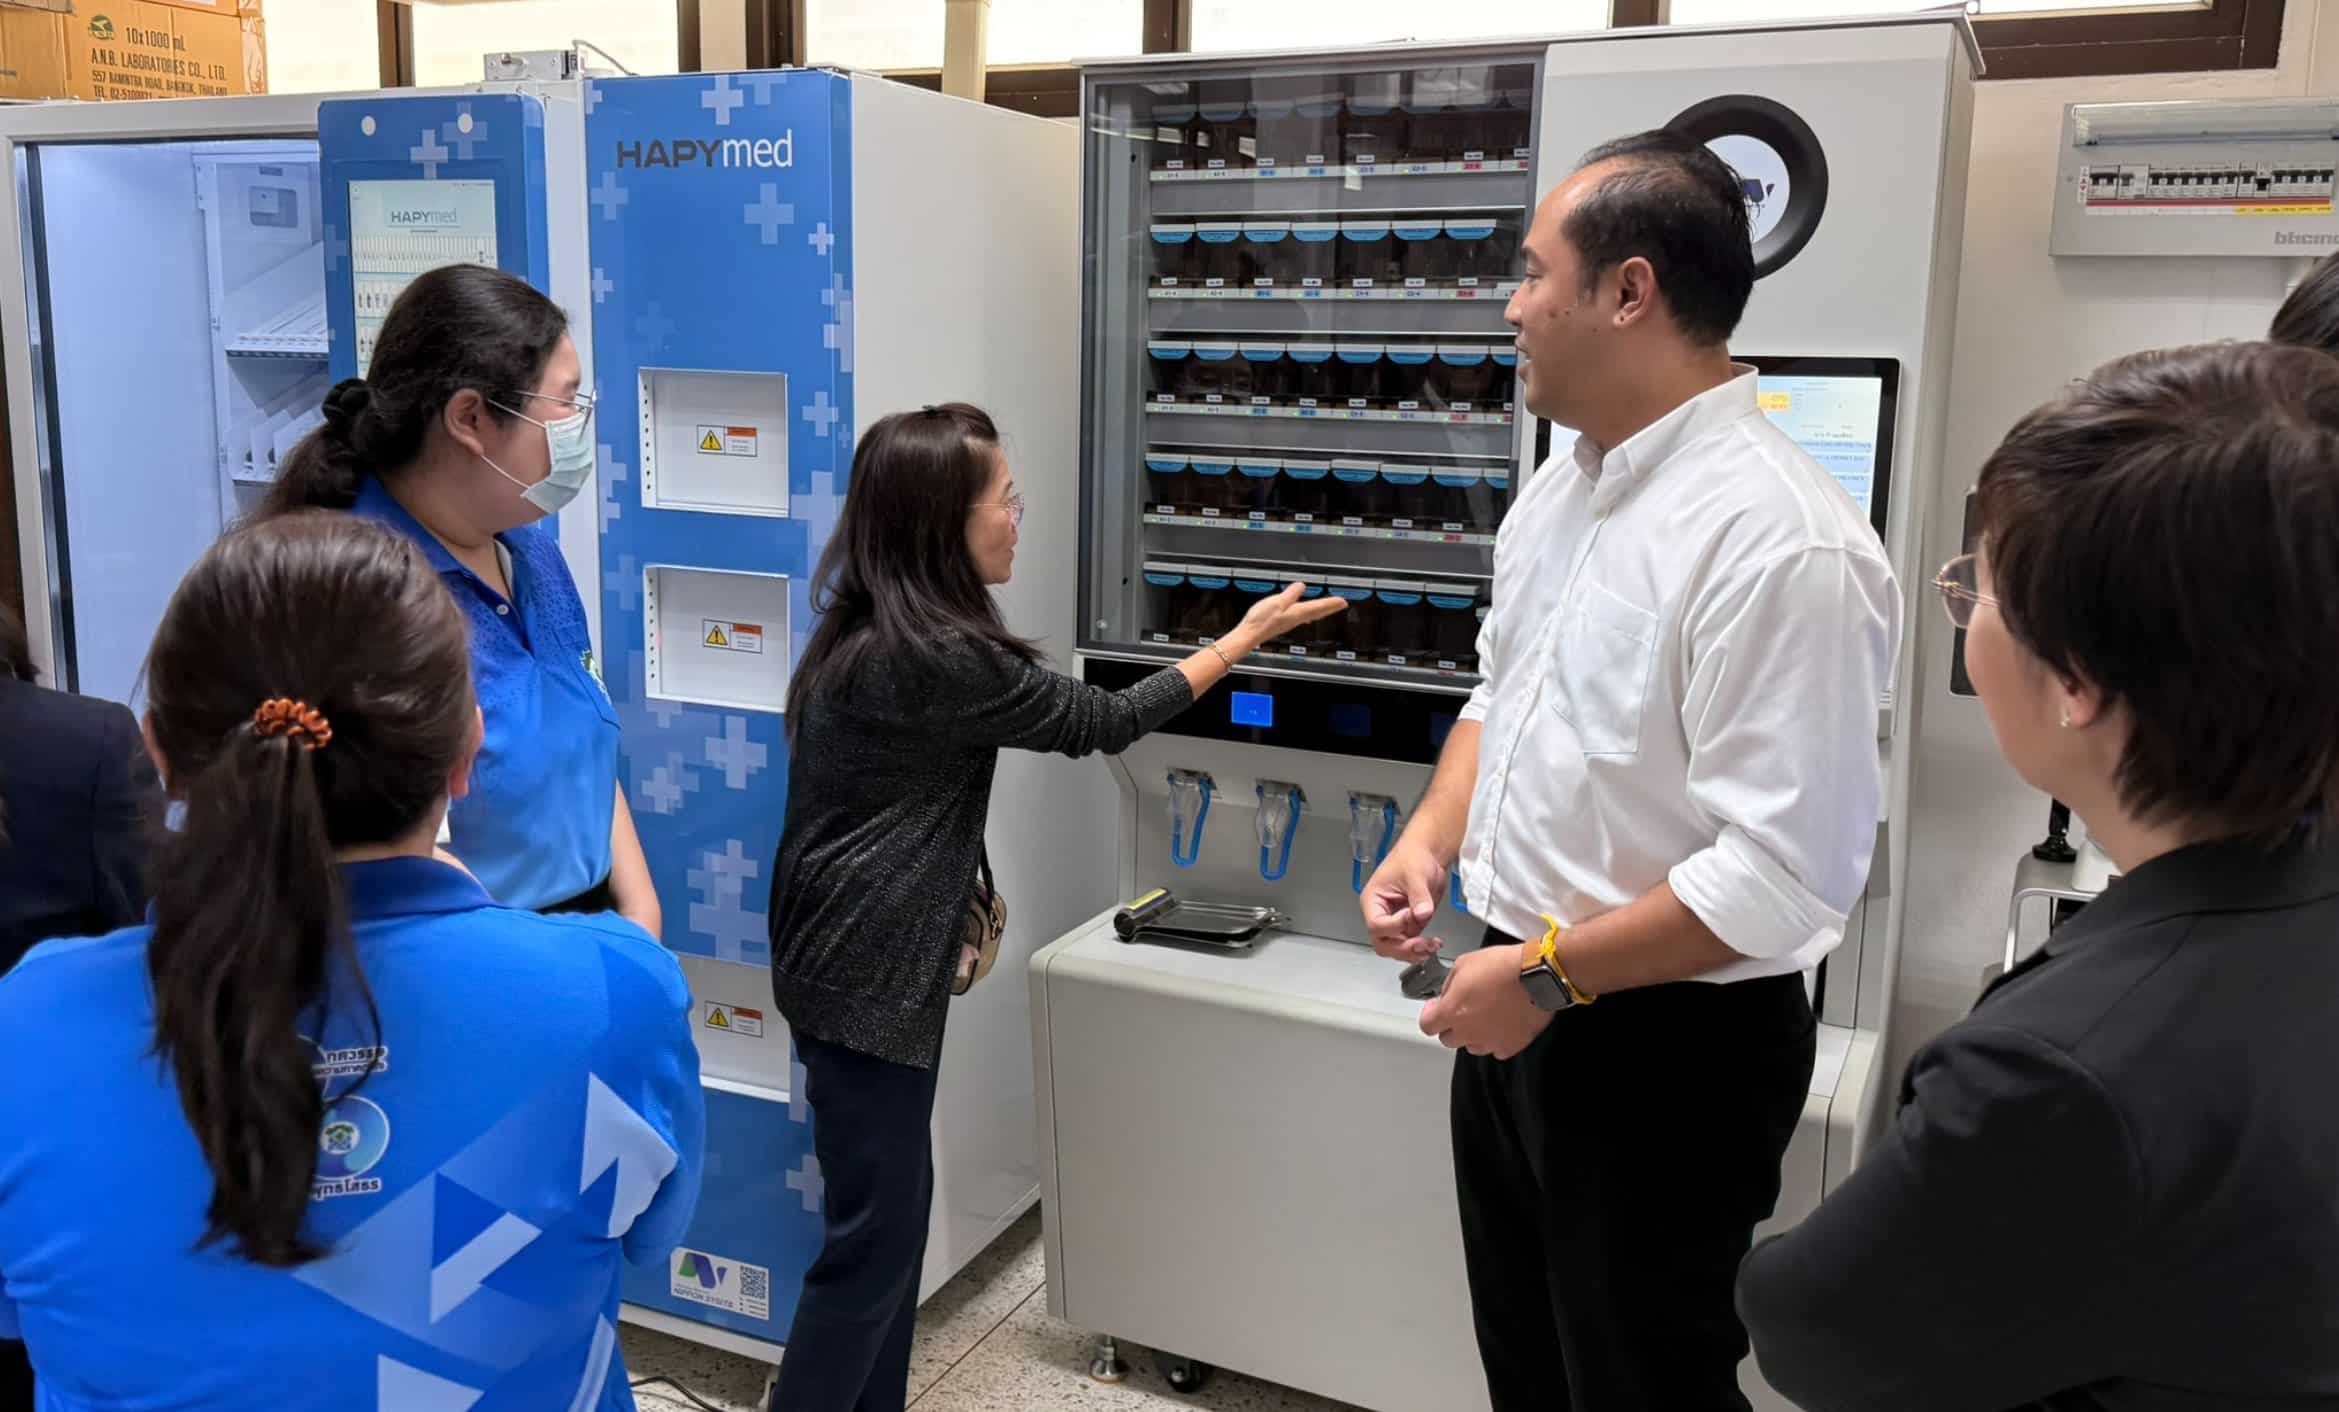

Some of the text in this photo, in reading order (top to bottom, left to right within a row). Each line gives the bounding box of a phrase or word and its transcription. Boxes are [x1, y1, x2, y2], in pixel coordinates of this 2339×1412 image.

[126, 27, 170, 48] 10x1000
[92, 48, 227, 80] A.N.B. LABORATORIES CO., LTD.
